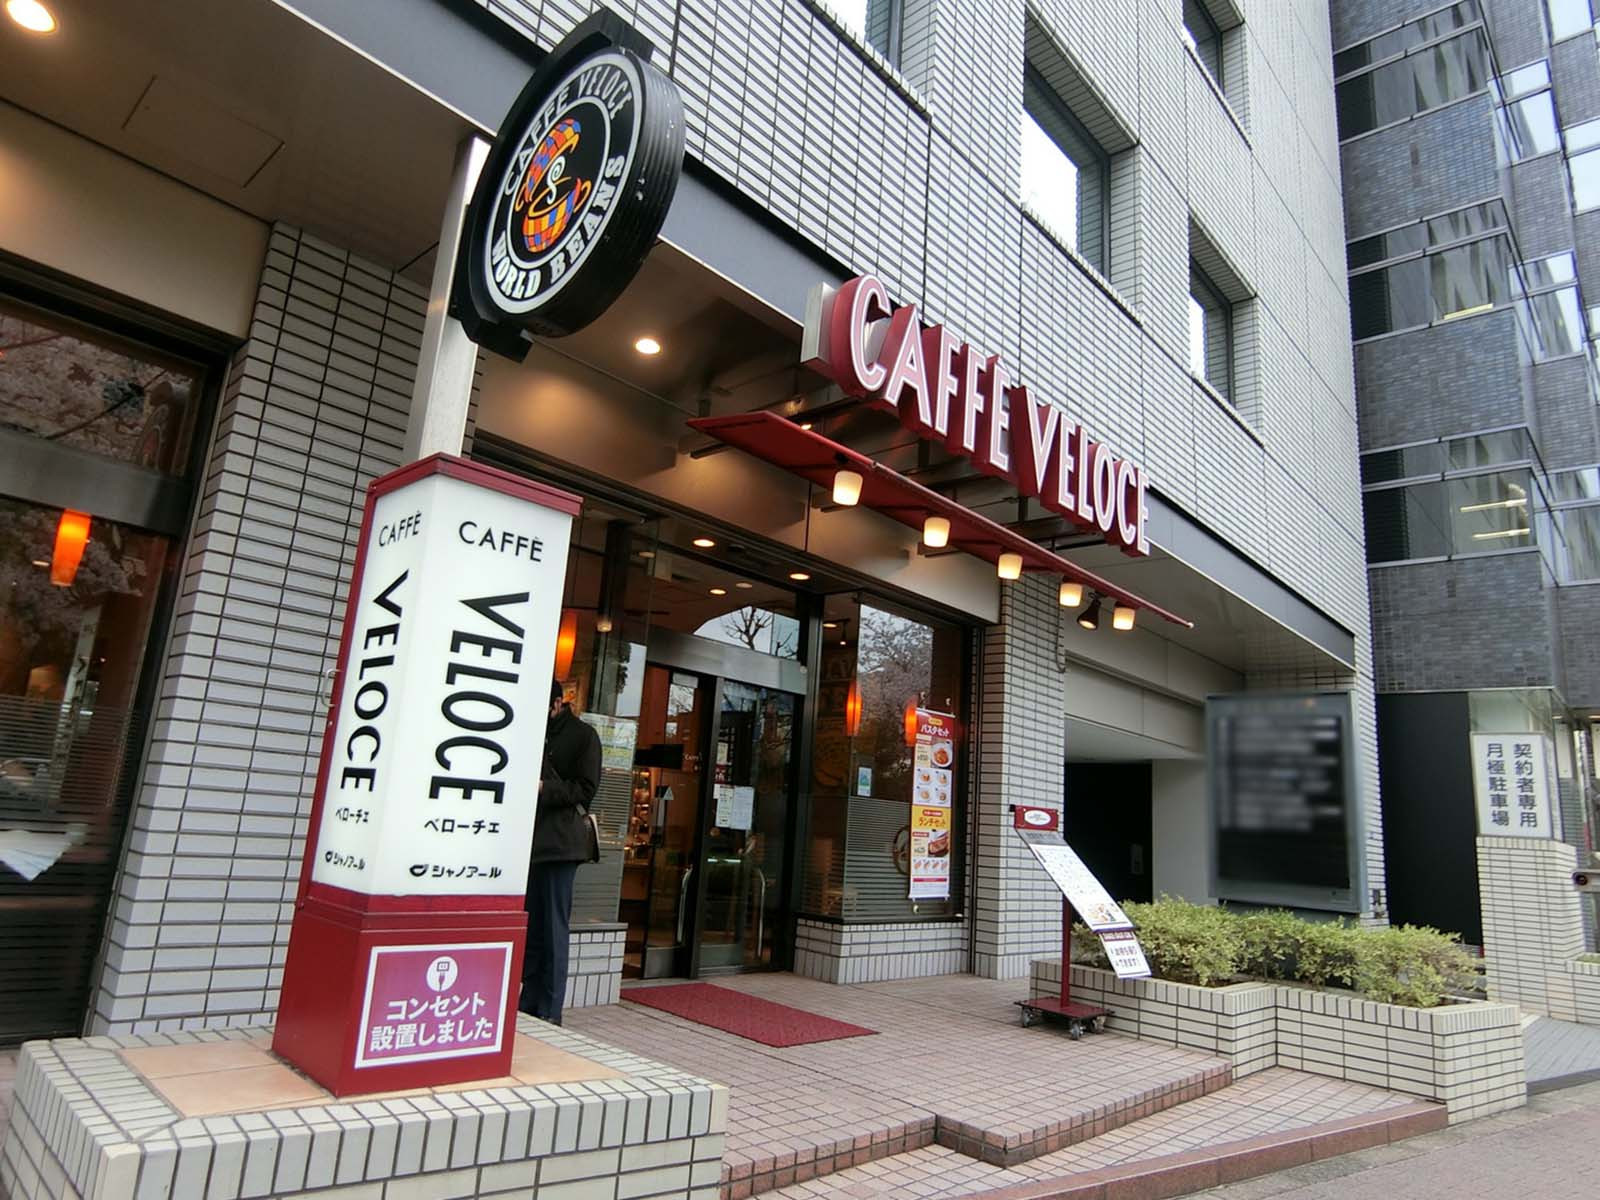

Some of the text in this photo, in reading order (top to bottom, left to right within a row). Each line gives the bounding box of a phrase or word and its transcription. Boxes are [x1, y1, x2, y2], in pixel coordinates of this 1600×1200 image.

[577, 66, 633, 120] VELOCE
[491, 154, 625, 299] WORLD BEANS
[1025, 387, 1150, 556] VELOCE
[379, 511, 422, 547] CAFFÈ
[459, 520, 544, 563] CAFFÈ
[341, 569, 410, 792] VELOCE
[428, 592, 530, 805] VELOCE
[1487, 743, 1510, 826] 月極駐車場
[1514, 743, 1538, 828] 契約者専用
[424, 818, 500, 834] ベローチェ
[432, 865, 502, 879] シャノアール
[386, 992, 486, 1021] コンセント
[372, 1017, 494, 1051] 設置しました
